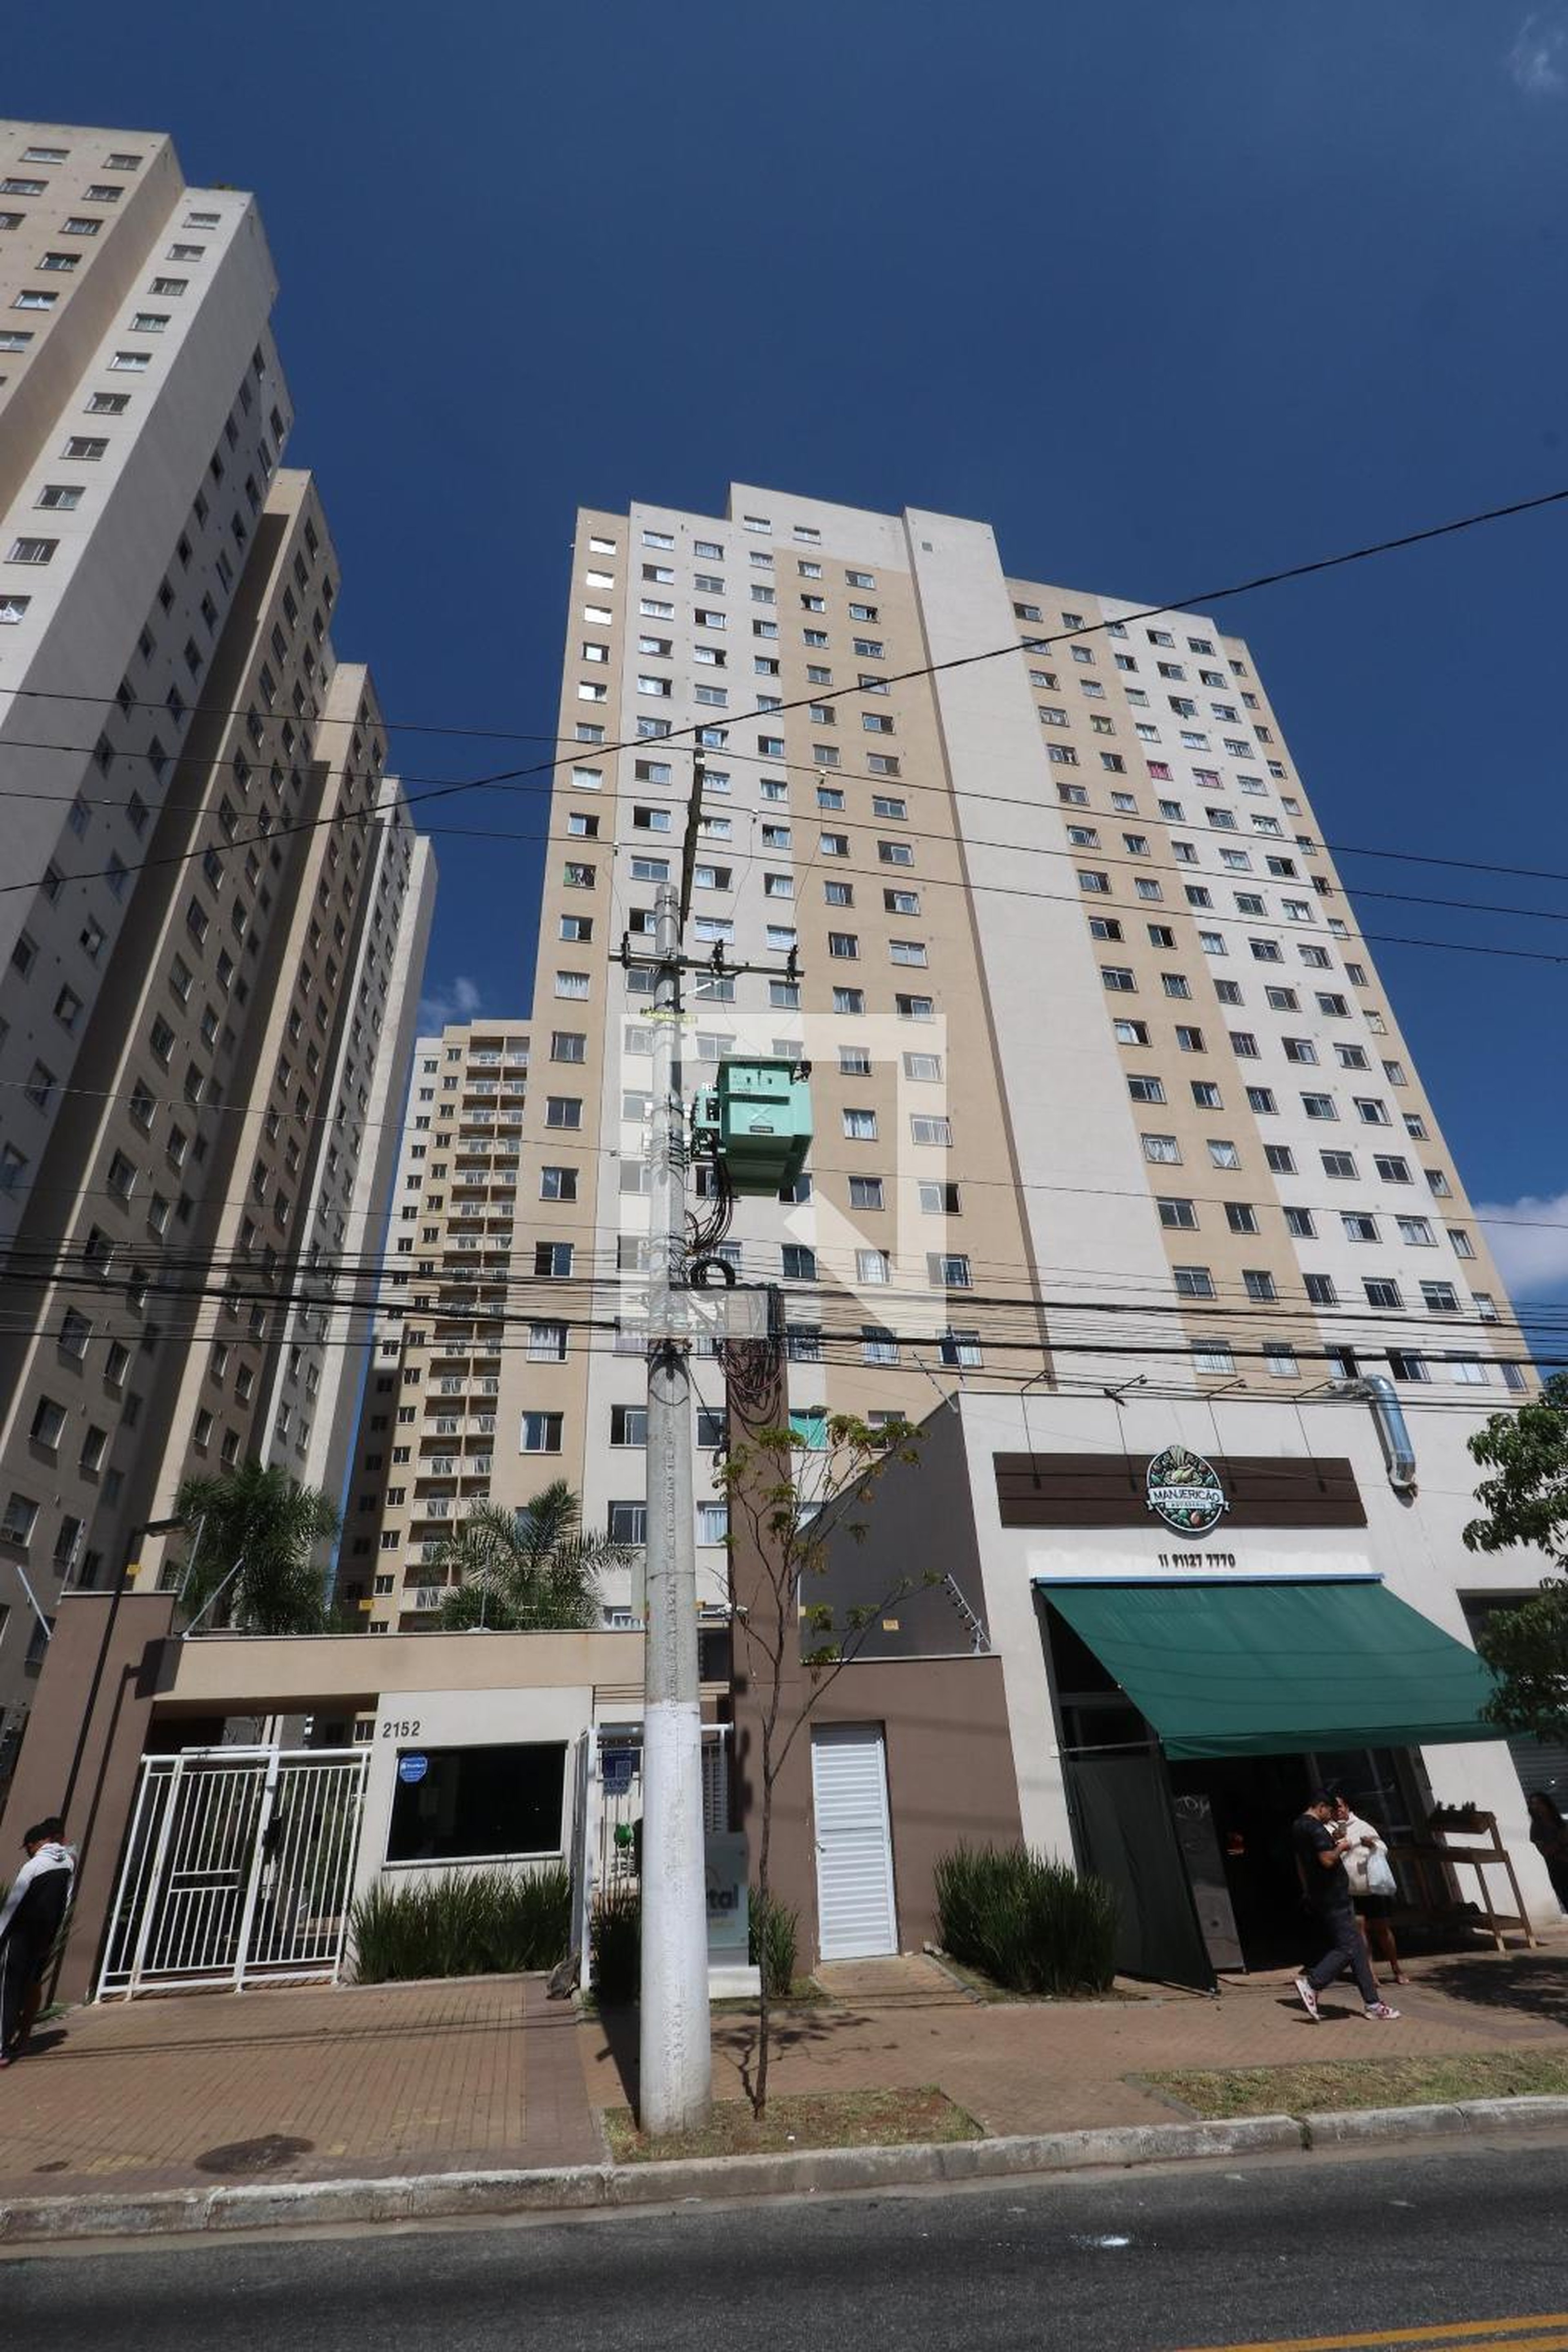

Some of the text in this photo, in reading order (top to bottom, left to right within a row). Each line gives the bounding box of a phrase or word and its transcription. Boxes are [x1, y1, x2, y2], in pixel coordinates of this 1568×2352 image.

[1153, 1490, 1220, 1503] MANJERICÃO
[1158, 1554, 1236, 1568] 11 91127 7770
[382, 1721, 420, 1738] 2152
